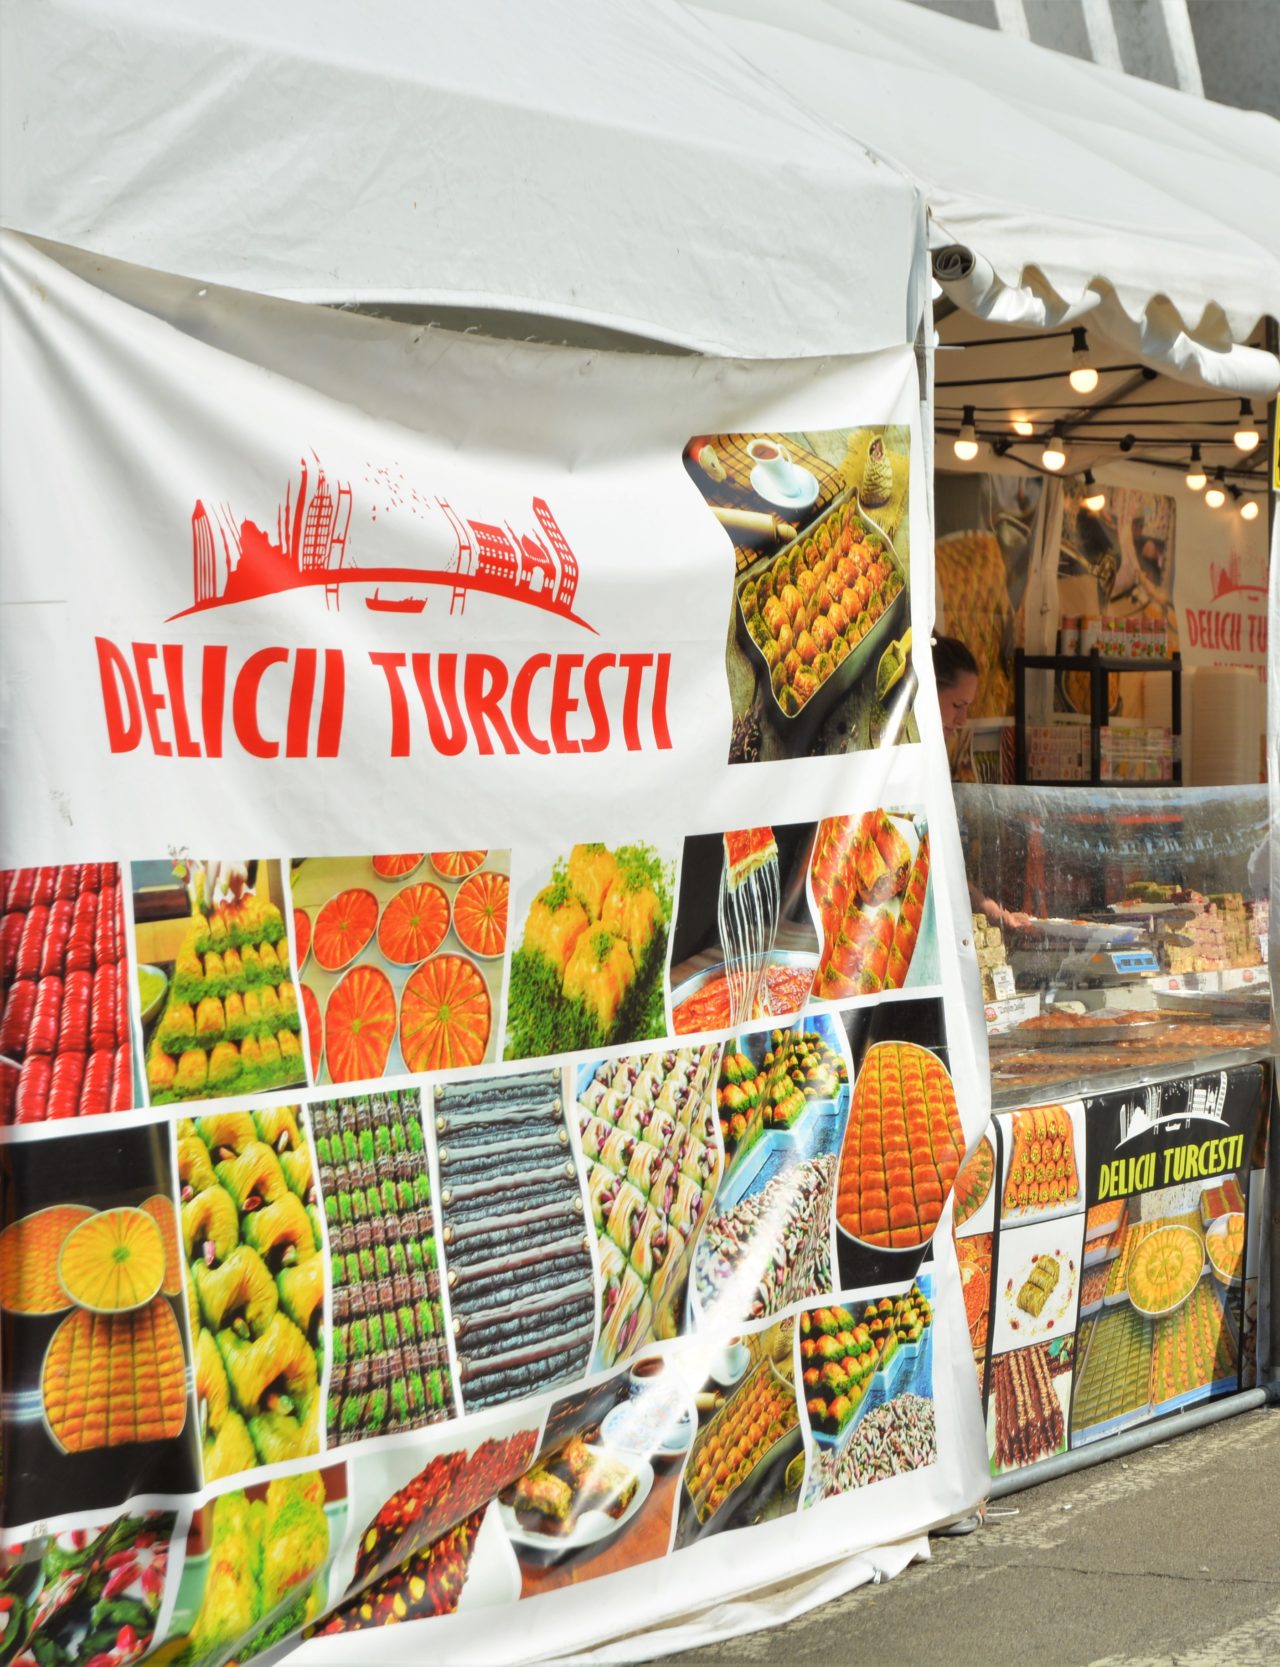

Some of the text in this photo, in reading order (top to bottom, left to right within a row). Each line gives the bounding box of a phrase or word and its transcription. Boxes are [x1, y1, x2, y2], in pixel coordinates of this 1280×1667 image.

[1185, 608, 1242, 652] DELICII
[94, 636, 673, 759] DELICII TURCESTI
[1098, 1134, 1244, 1200] DELICII TURCESTI
